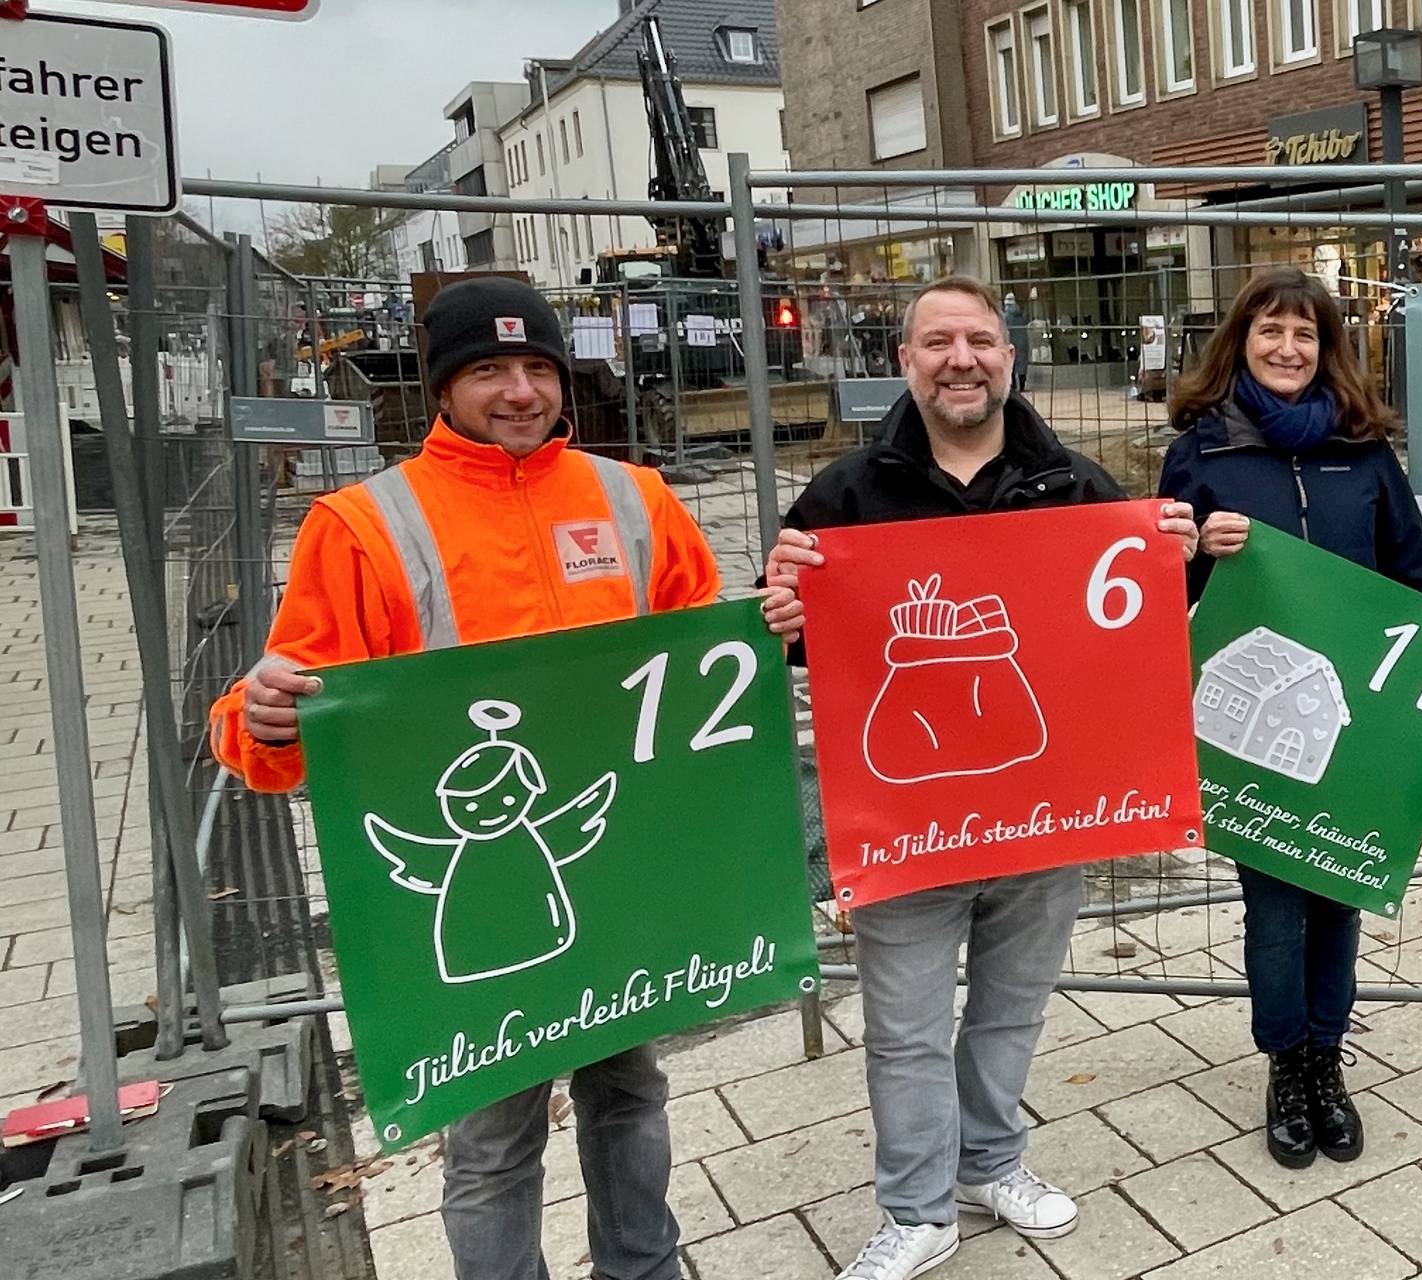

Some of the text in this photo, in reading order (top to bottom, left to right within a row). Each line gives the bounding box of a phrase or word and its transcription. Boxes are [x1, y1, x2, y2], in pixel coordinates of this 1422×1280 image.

[1286, 128, 1362, 165] Tchibo
[1086, 183, 1135, 211] SHOP
[565, 557, 617, 570] FLORACK
[1087, 536, 1147, 630] 6
[620, 640, 758, 763] 12
[861, 789, 1172, 868] In Jülich steckt viel drin!
[1235, 783, 1301, 829] knusper,
[1218, 816, 1265, 842] steht
[1262, 835, 1304, 860] mein
[1305, 847, 1390, 890] Häuschen!
[405, 935, 777, 1106] Jülich verleiht Flügel!
